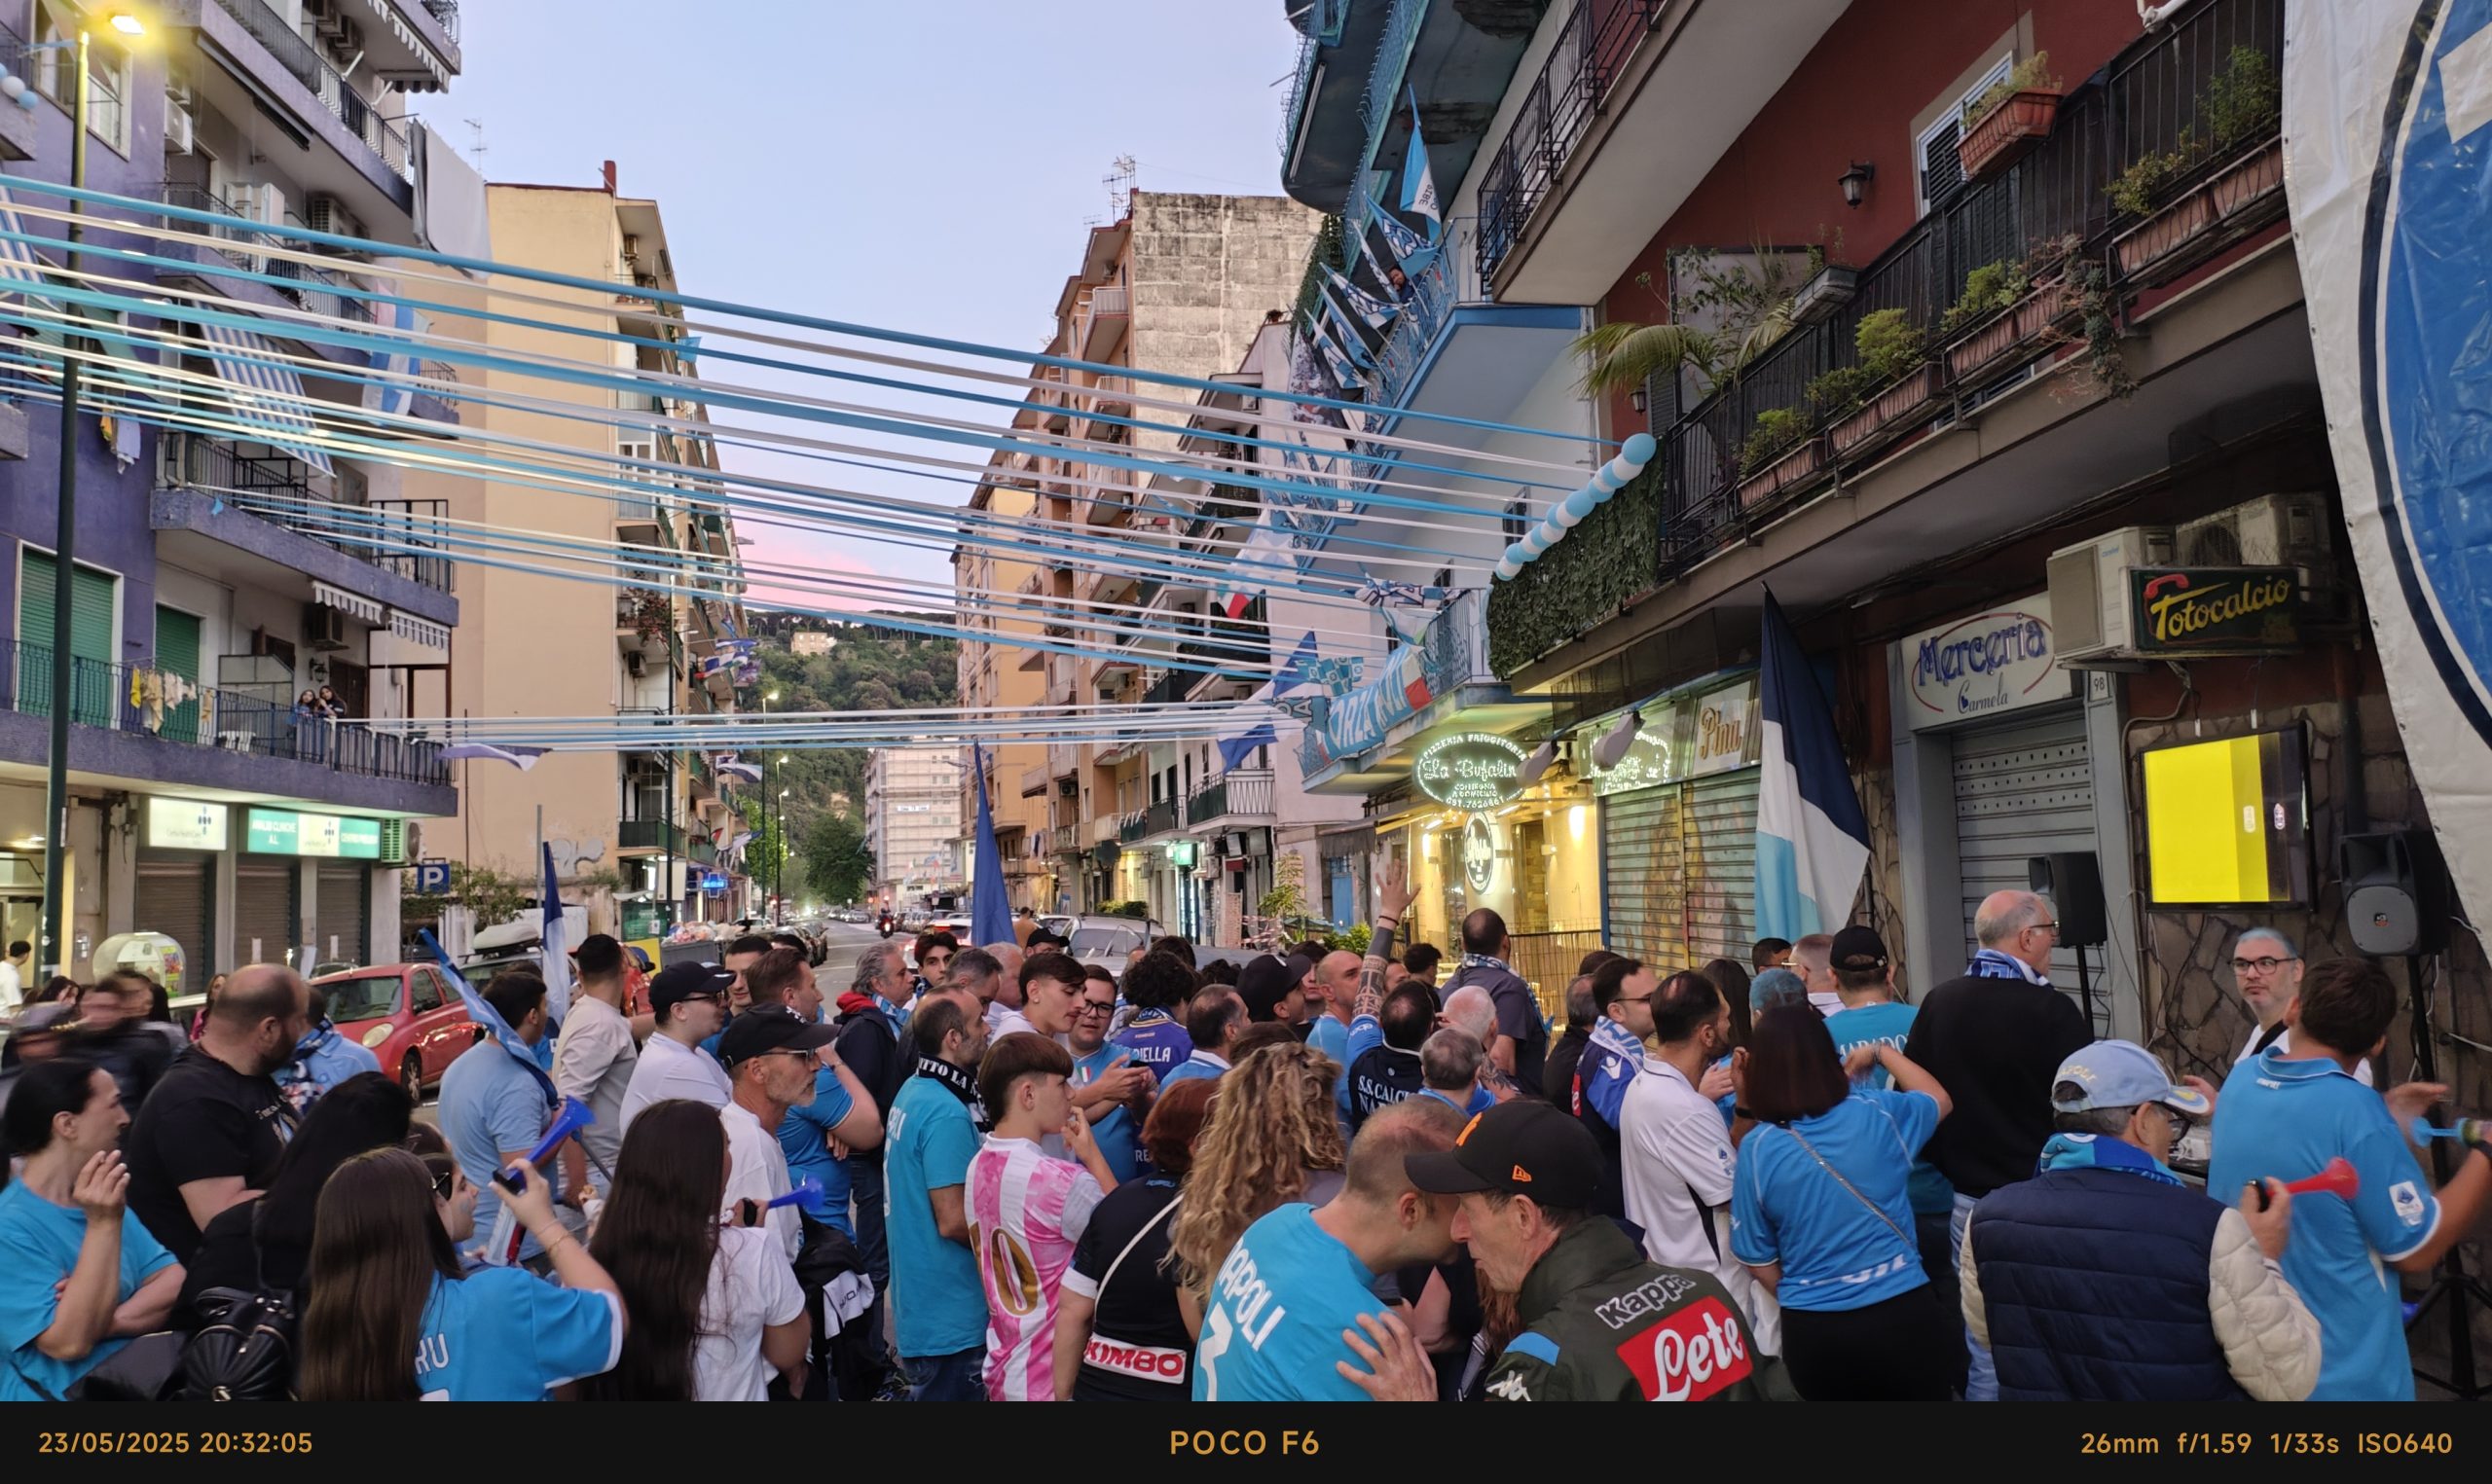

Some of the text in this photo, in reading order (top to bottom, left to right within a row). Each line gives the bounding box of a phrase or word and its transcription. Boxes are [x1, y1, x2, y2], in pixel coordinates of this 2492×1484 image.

[2150, 575, 2290, 641] Totocalcio
[1919, 614, 2047, 687] Merceria
[1958, 672, 2008, 714] Carmela
[2094, 675, 2106, 692] 98
[1423, 734, 1527, 761] PIZZERIA FRIGGITORIA
[1422, 758, 1518, 781] La Bufalin
[423, 867, 444, 891] P
[1374, 1083, 1411, 1104] CALCI
[1135, 1149, 1154, 1162] RE
[1594, 1275, 1697, 1329] Kappa
[1084, 1340, 1184, 1377] KIMBO
[1650, 1311, 1743, 1401] Lete
